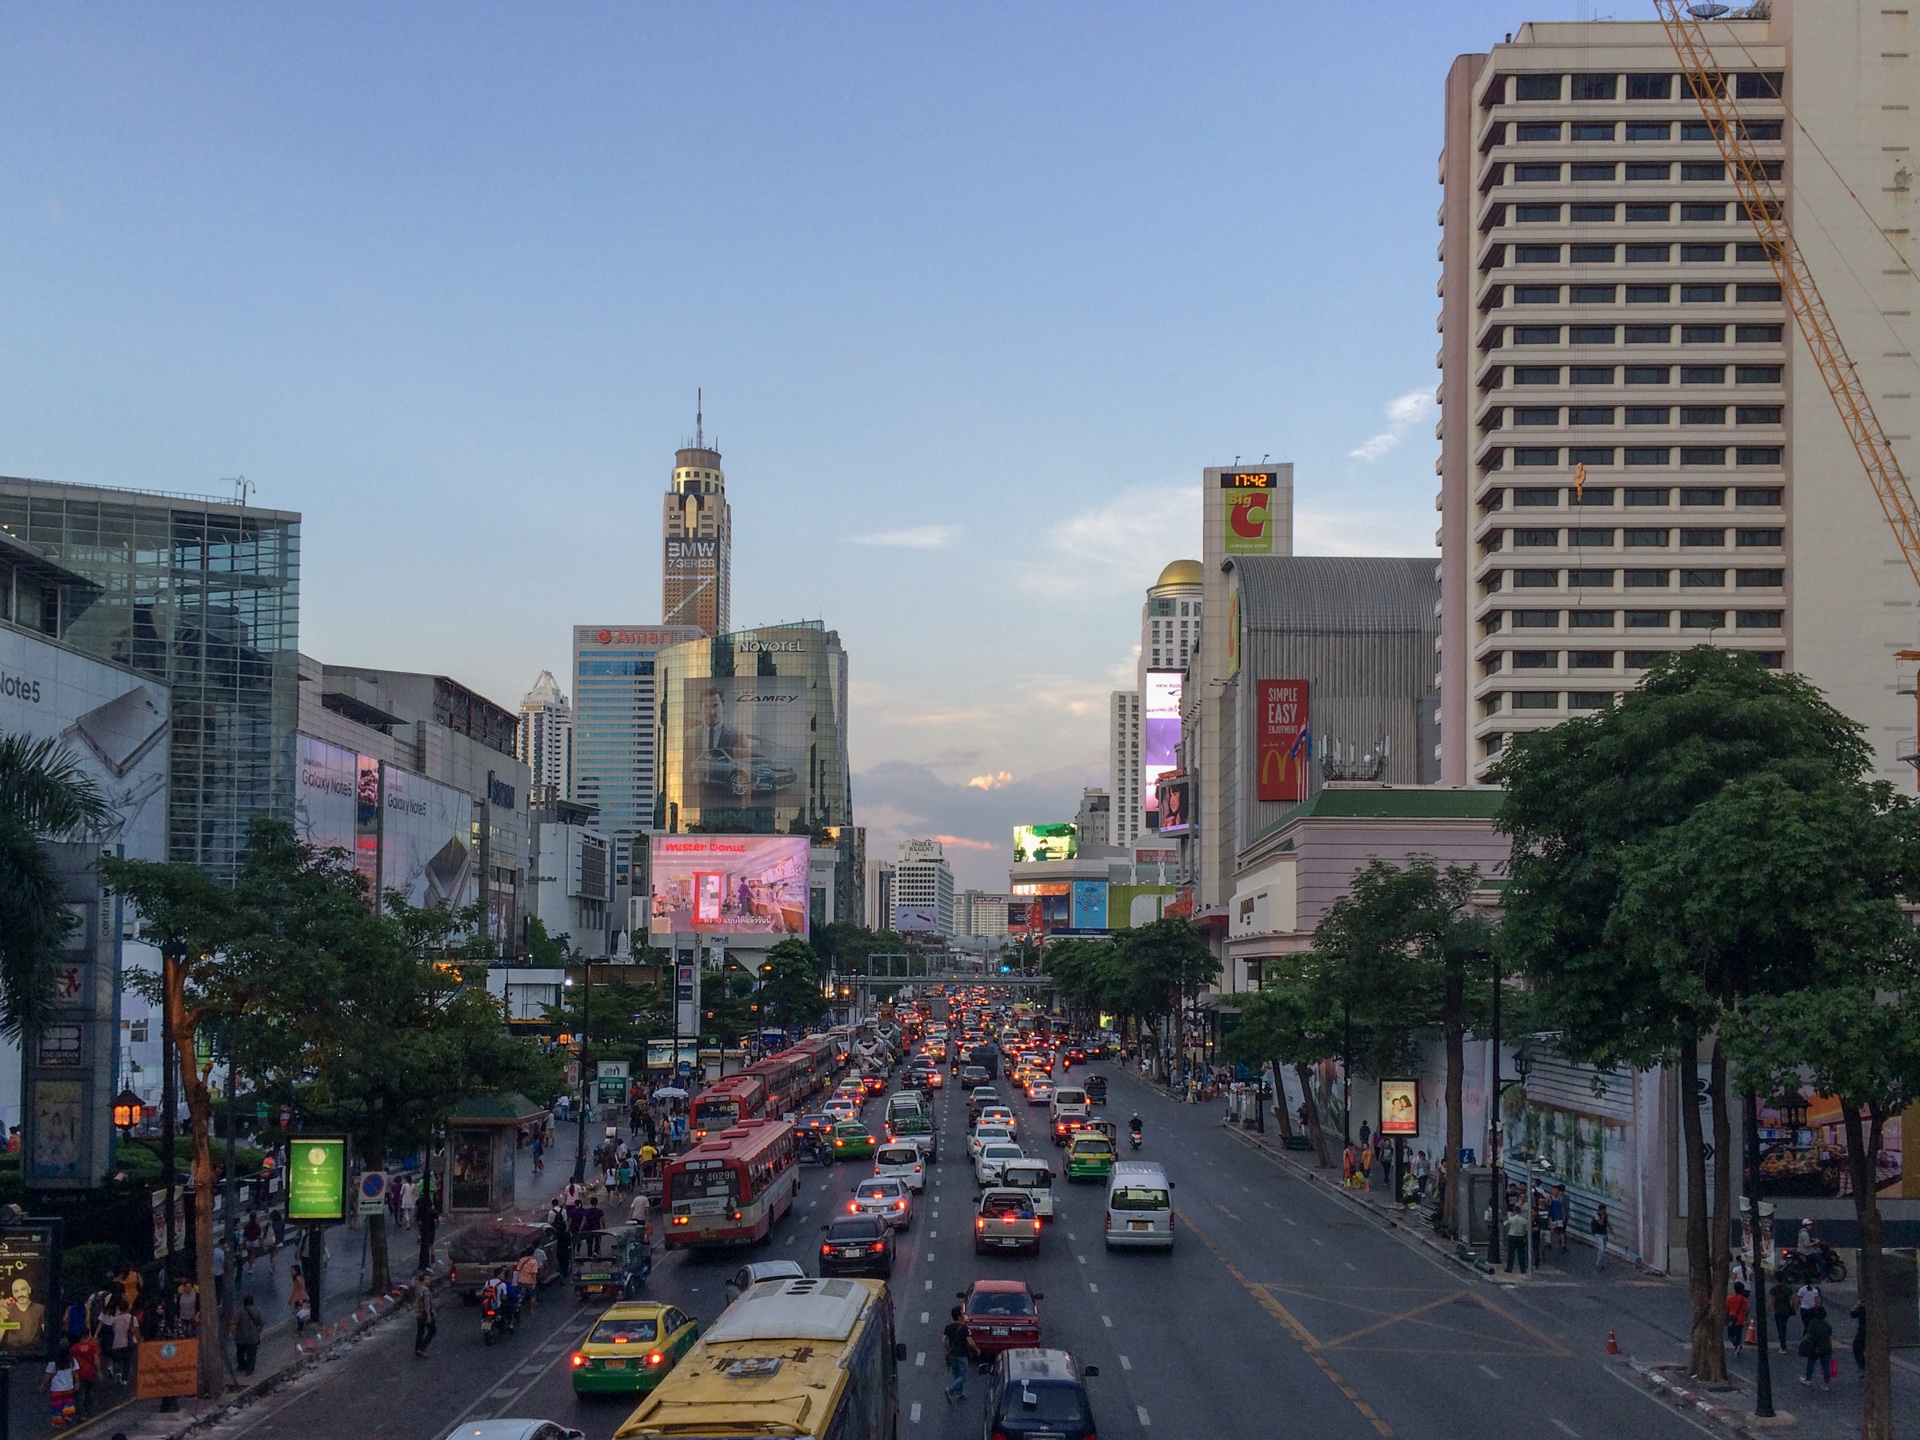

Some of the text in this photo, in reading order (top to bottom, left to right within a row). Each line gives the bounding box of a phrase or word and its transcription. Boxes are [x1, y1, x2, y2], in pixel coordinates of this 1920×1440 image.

[1235, 474, 1268, 487] 17:42
[1229, 495, 1252, 508] Big
[1231, 492, 1270, 539] C
[668, 542, 716, 557] BMW
[668, 559, 715, 568] 7 SERIES
[614, 629, 674, 644] Amari
[739, 640, 806, 652] NOVOTEL
[736, 694, 799, 703] CAMRY
[1268, 687, 1298, 702] SIMPLE
[1268, 703, 1298, 724] EASY
[1268, 725, 1298, 735] ENJOYMENT
[302, 769, 353, 797] Galaxy Note5
[387, 792, 427, 816] Galaxy Note5
[665, 843, 746, 852] mister Donut
[706, 1170, 736, 1182] 40298
